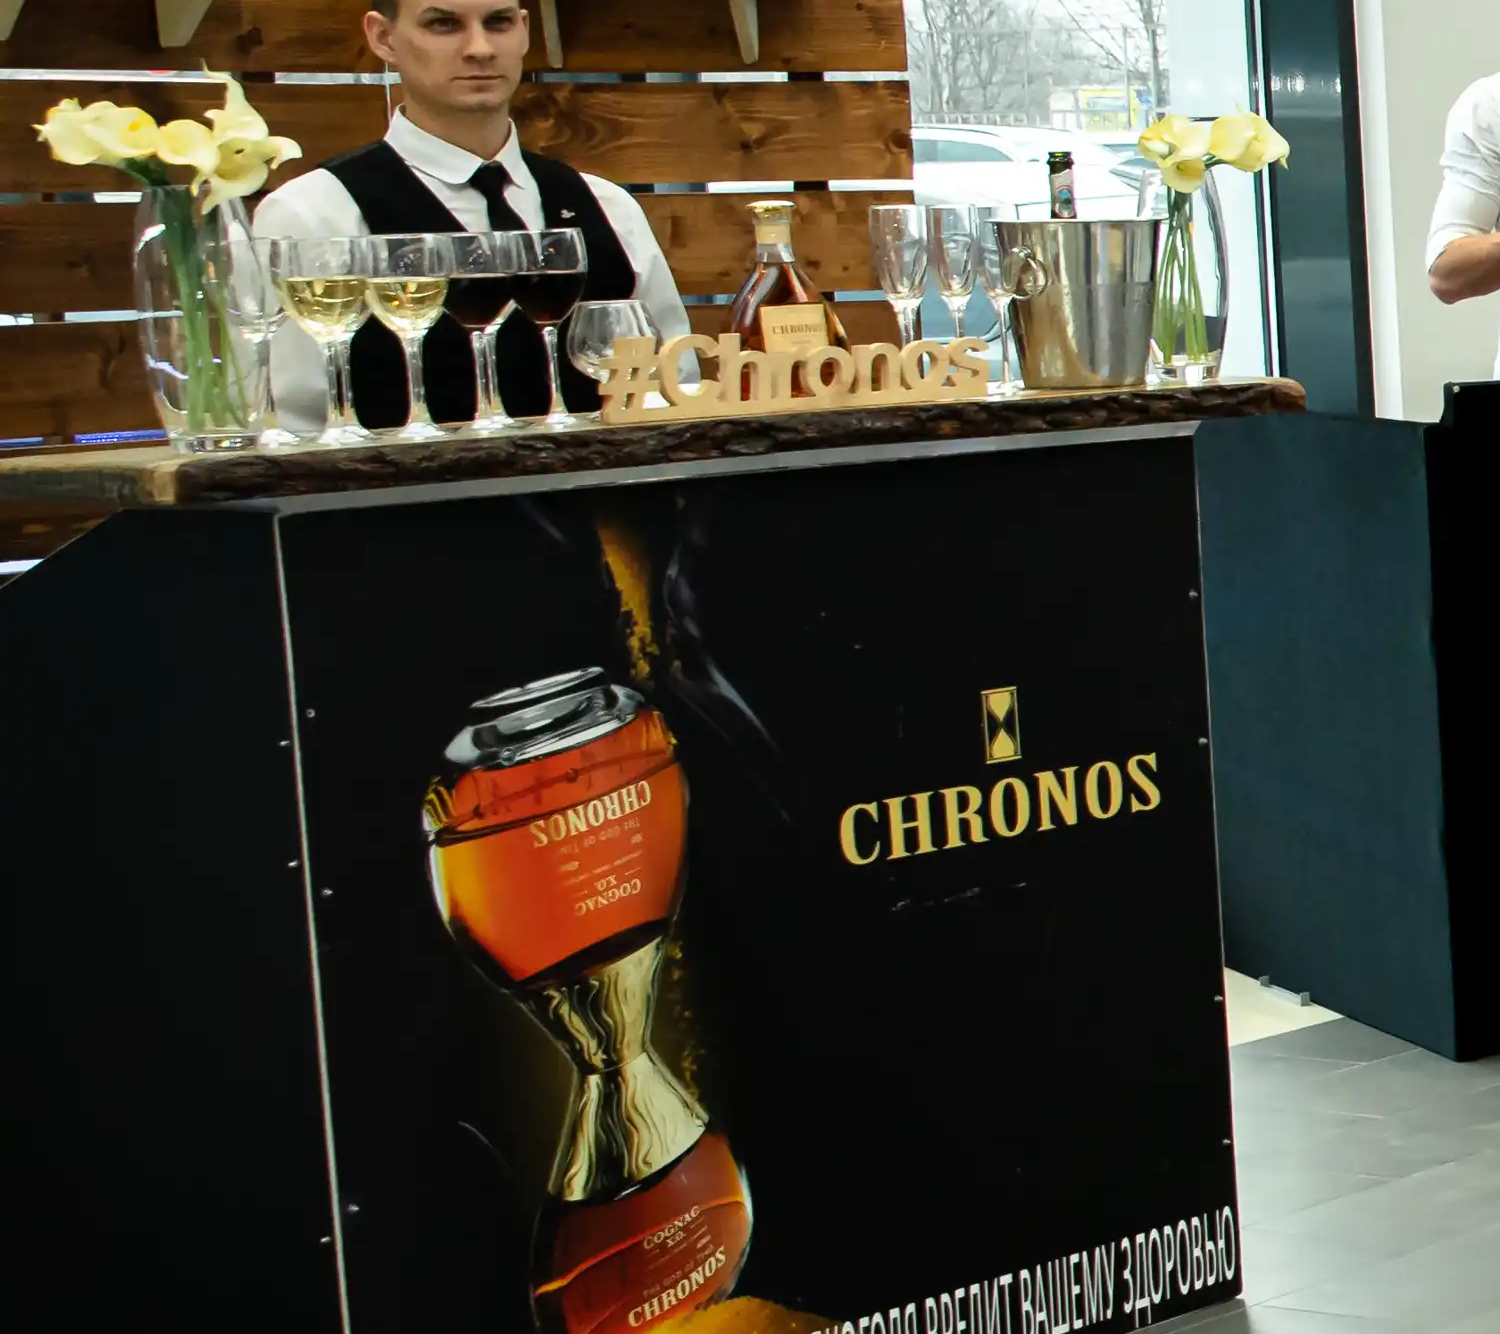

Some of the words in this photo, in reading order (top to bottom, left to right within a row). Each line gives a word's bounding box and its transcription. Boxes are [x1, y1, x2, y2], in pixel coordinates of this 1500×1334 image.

[598, 332, 990, 413] #Chronos
[529, 780, 652, 849] CHRONOS
[839, 751, 1162, 866] CHRONOS
[574, 878, 642, 917] COGNAC
[643, 1205, 701, 1250] COGNAC
[1122, 1205, 1237, 1330] ЗДОРОВЬЮ
[628, 1245, 727, 1328] CHRONOS
